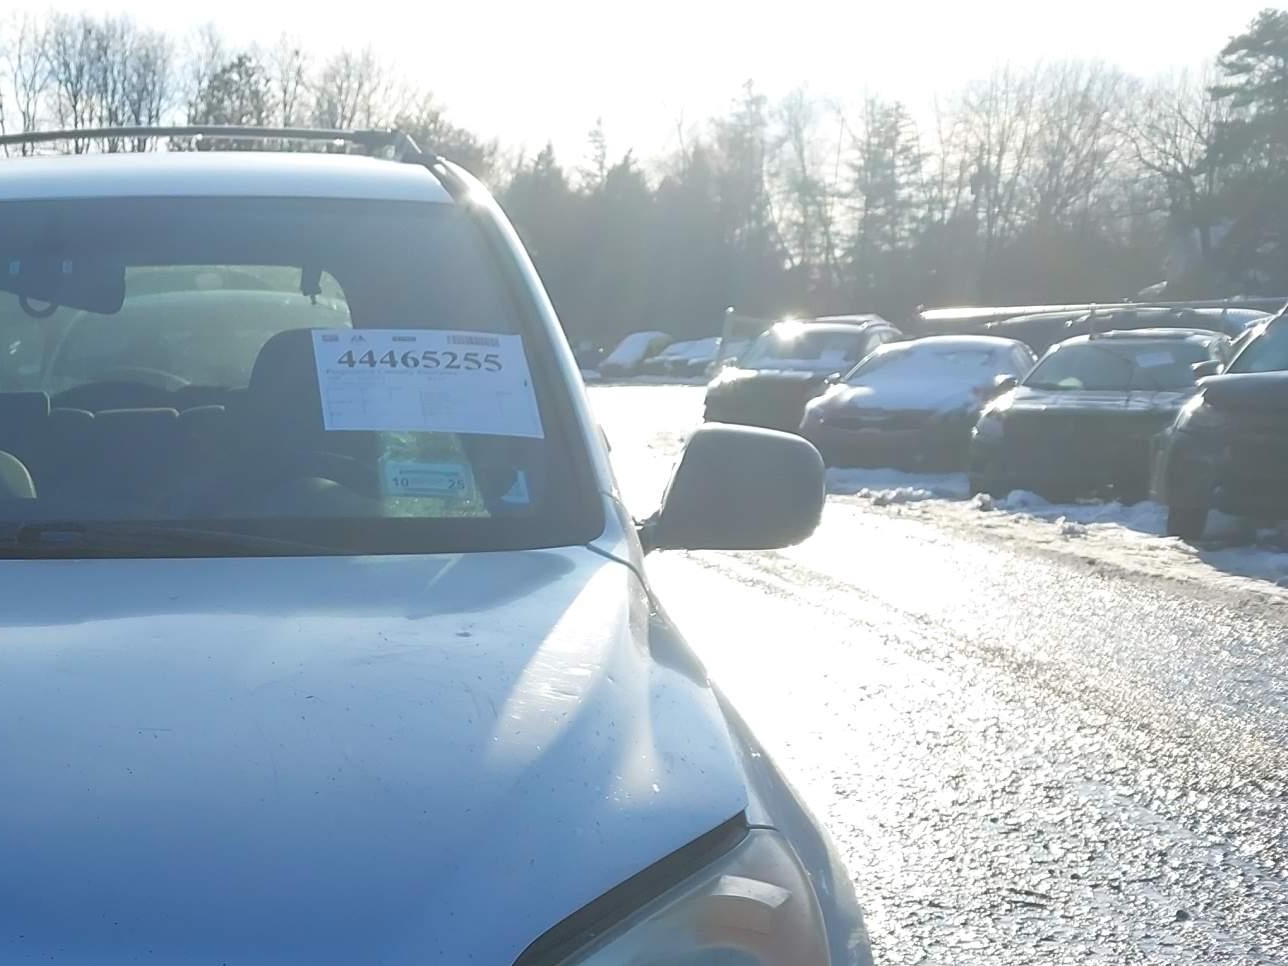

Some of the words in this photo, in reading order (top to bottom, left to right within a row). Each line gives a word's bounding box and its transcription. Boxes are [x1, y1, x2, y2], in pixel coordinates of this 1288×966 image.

[337, 349, 503, 373] 44465255
[392, 477, 409, 487] 10
[447, 479, 465, 489] 25
